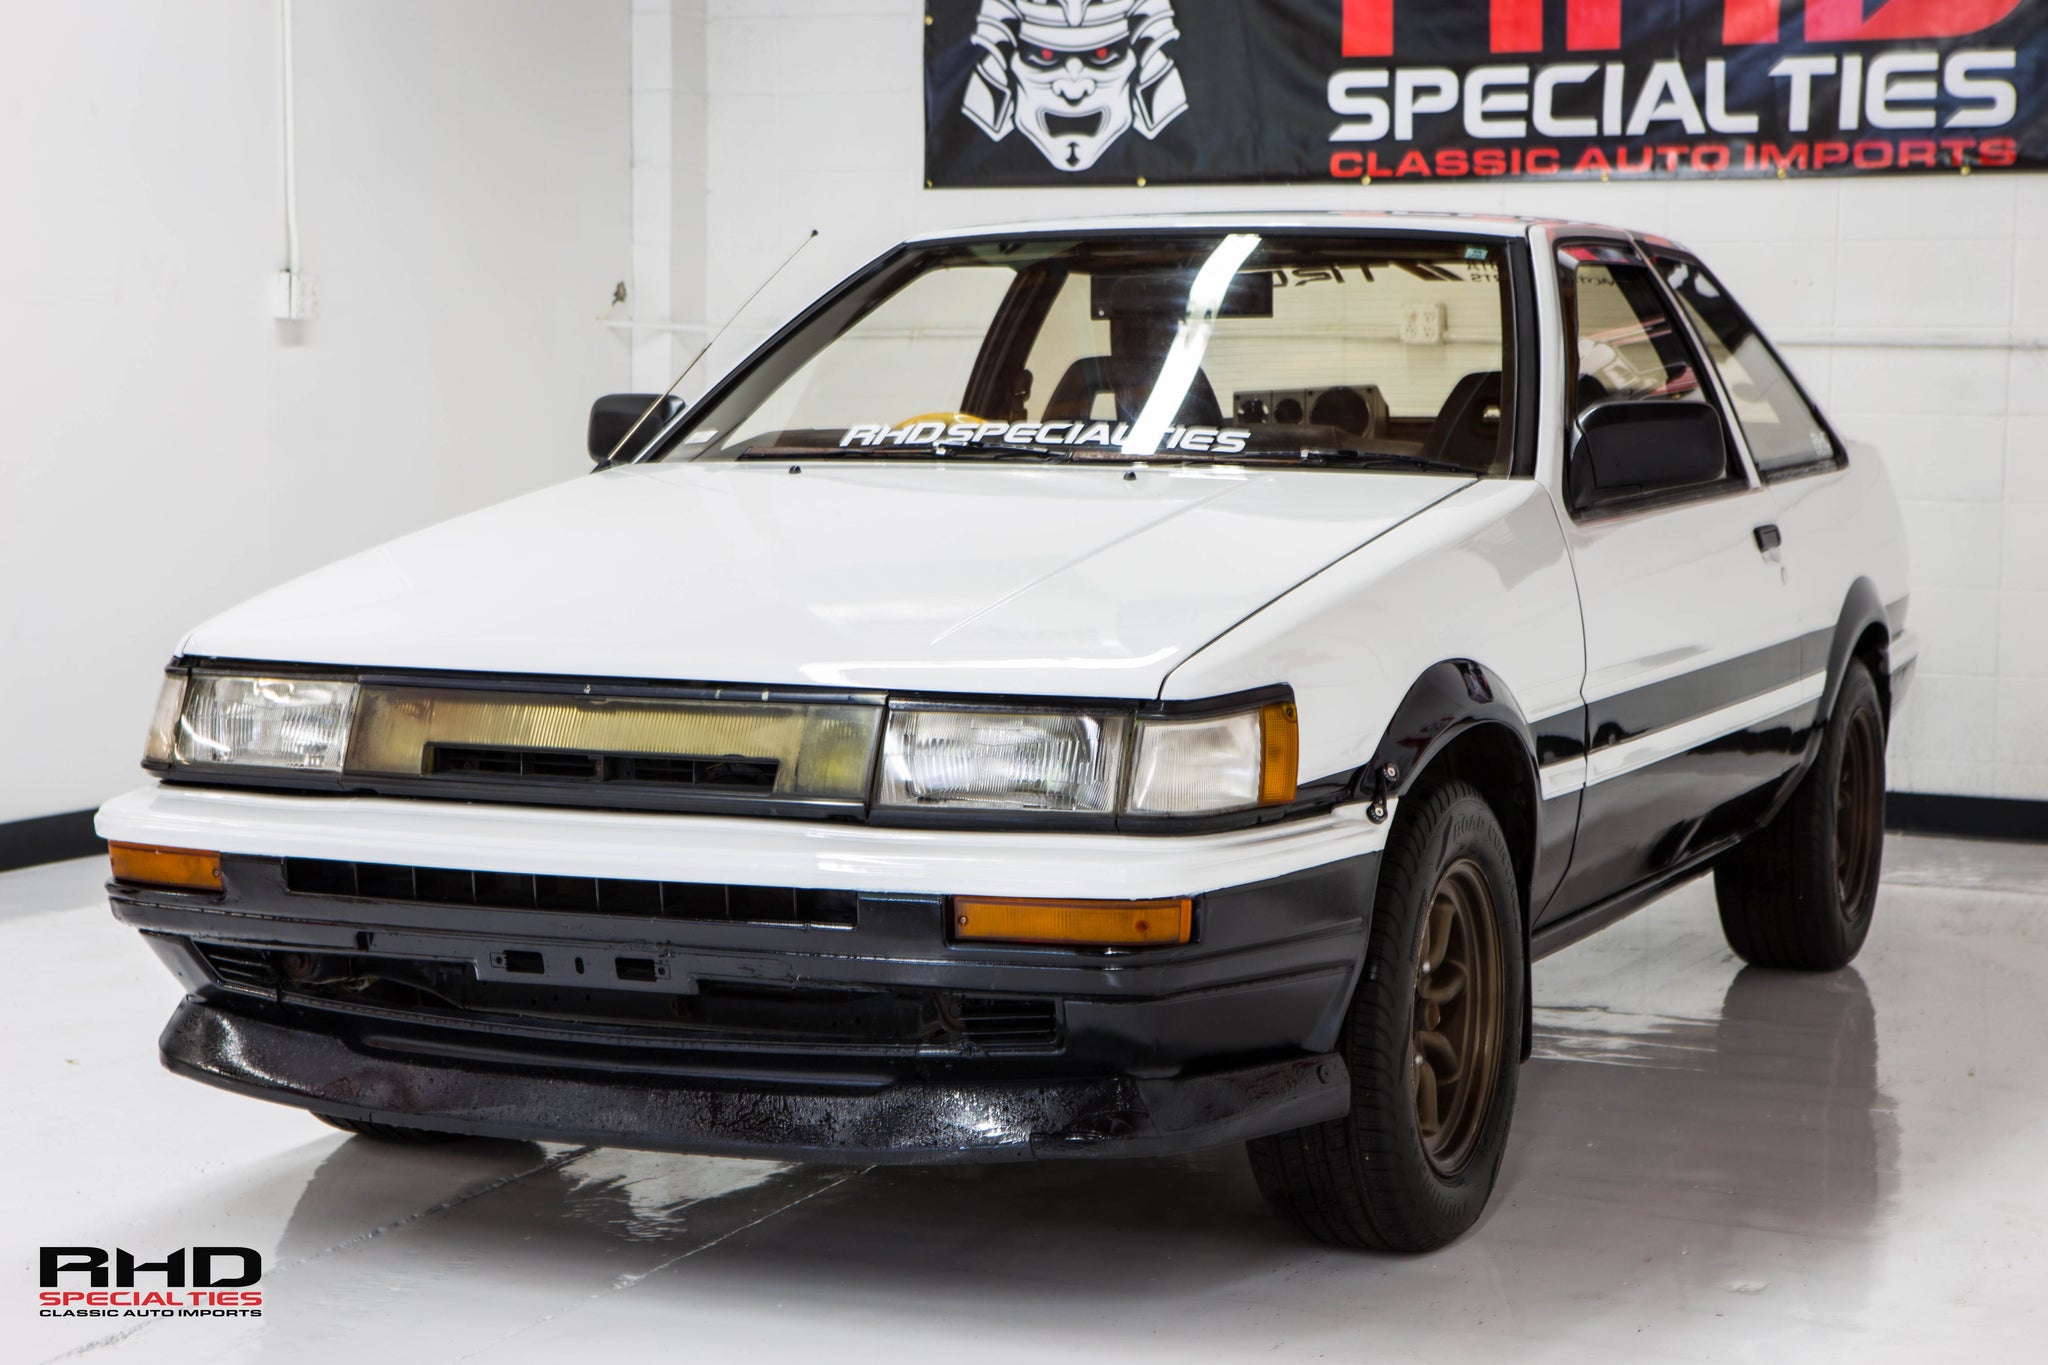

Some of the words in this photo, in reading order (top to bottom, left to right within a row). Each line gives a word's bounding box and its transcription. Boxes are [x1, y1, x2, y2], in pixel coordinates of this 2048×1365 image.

[1327, 50, 2017, 142] SPECIALTIES
[1329, 148, 1560, 178] CLASSIC
[1573, 144, 1730, 174] AUTO
[1743, 137, 2017, 172] IMPORTS
